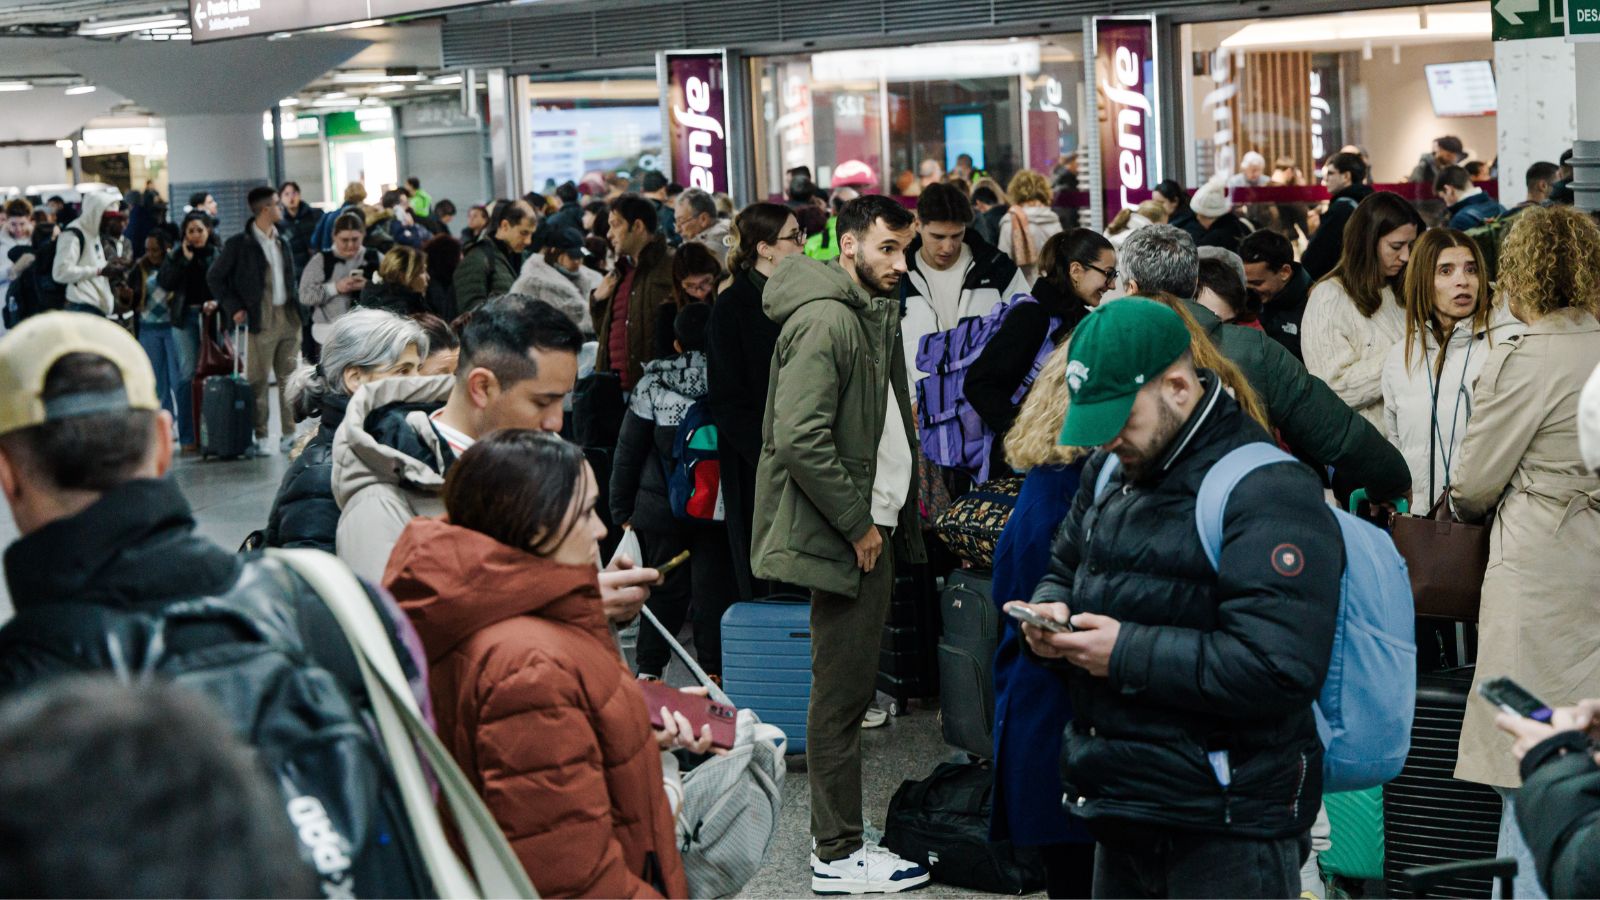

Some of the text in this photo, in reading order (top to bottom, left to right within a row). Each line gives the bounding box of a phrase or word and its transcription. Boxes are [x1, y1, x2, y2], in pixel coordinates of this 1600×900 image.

[1577, 9, 1600, 22] DES
[674, 76, 724, 195] enfe
[1102, 46, 1152, 212] renfe
